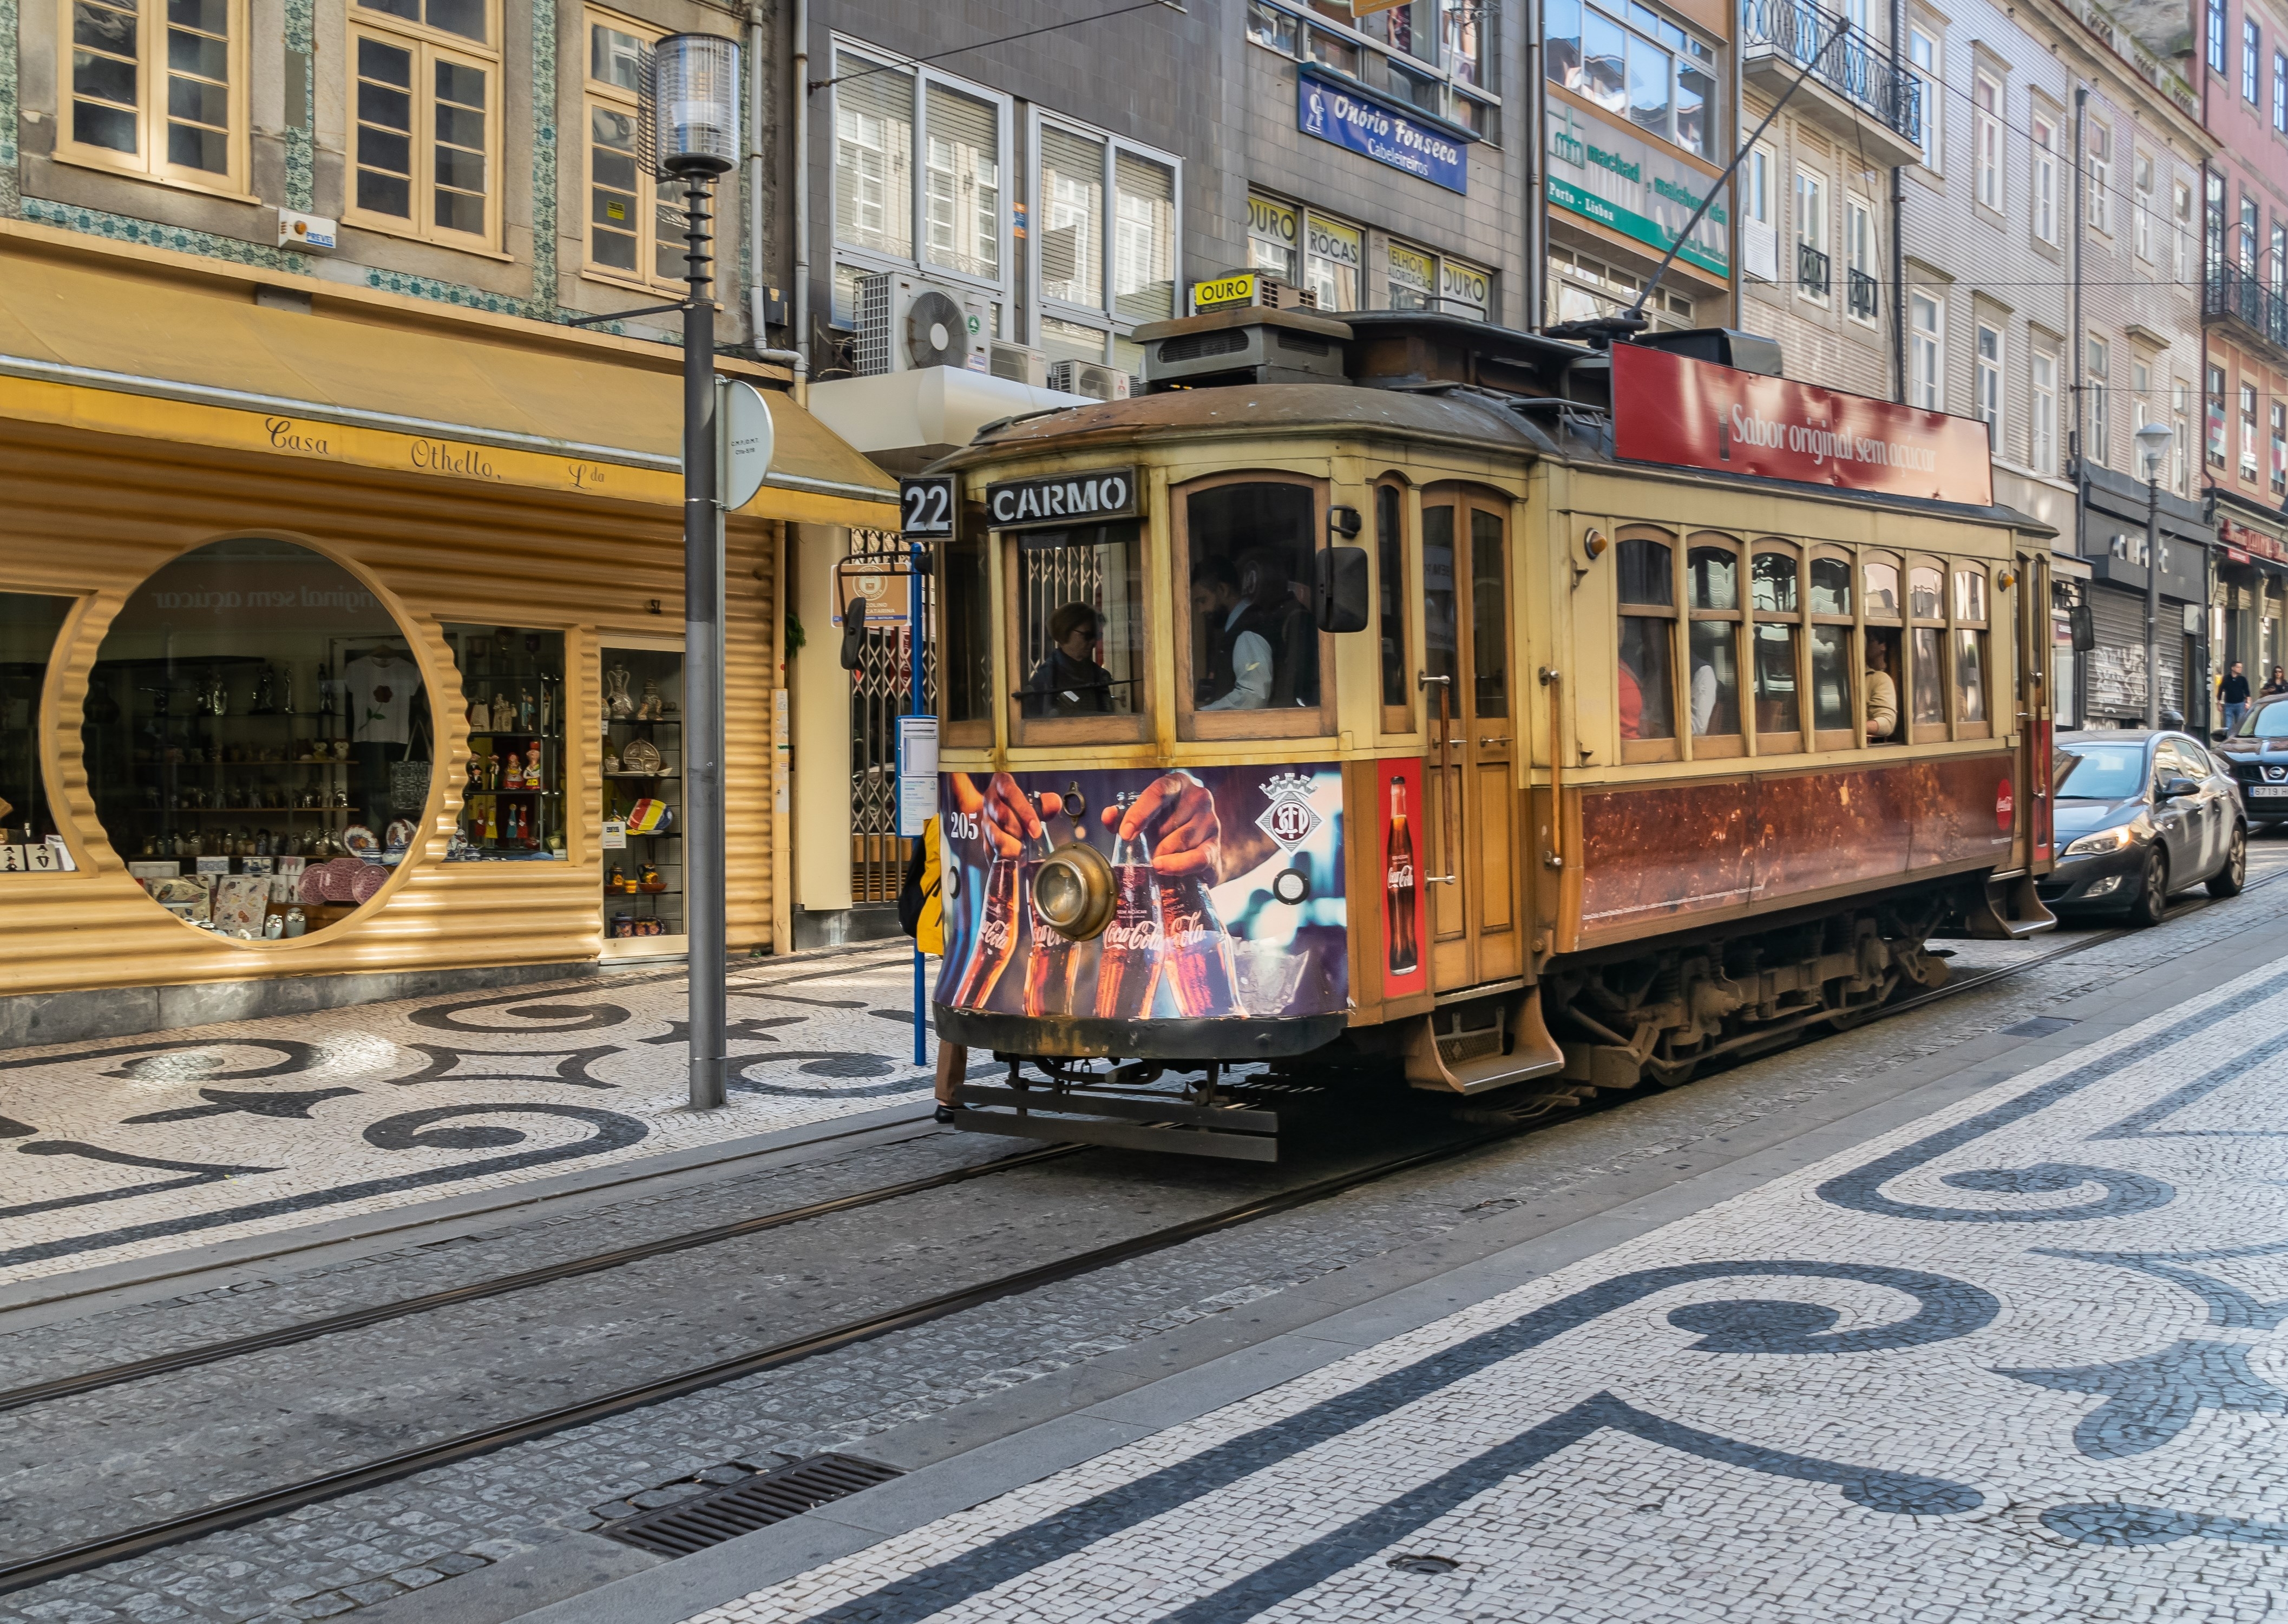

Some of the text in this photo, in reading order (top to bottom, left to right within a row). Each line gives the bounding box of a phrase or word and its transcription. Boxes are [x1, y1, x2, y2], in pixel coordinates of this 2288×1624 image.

[1334, 95, 1459, 166] Onório Fonseca
[1367, 137, 1429, 176] Cabeleireiros
[1549, 182, 1575, 205] Porto
[1585, 197, 1614, 221] Lisboa
[1202, 279, 1248, 302] OURO
[265, 417, 329, 455] Casa
[1732, 403, 1937, 478] Sabor original sem açúcar
[905, 485, 949, 531] 22
[993, 477, 1127, 521] CARMO
[2255, 788, 2278, 796] 6719
[950, 811, 979, 840] 205
[1103, 920, 1163, 951] Coca-Cola
